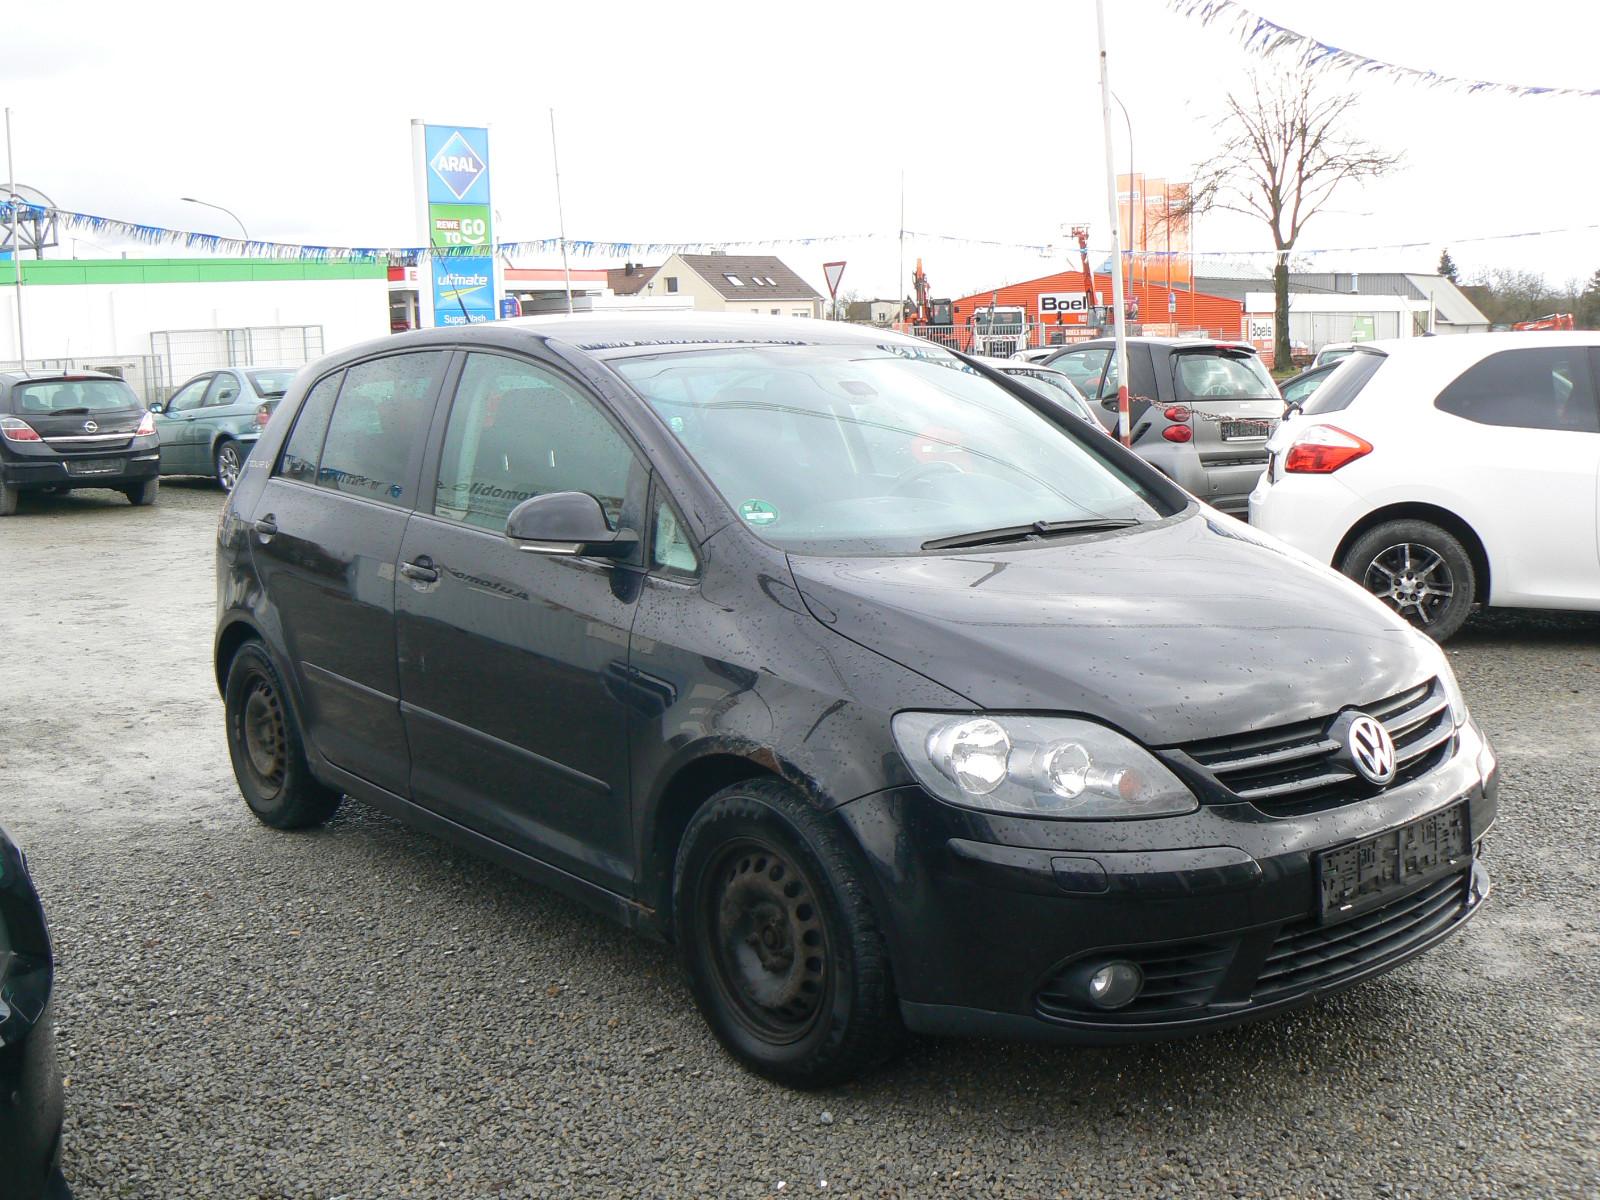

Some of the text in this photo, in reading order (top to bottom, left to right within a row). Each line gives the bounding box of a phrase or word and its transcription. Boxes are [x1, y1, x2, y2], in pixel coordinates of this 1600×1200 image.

[438, 156, 478, 173] ARAL
[436, 220, 459, 230] REWE
[461, 218, 486, 236] GO
[444, 232, 461, 244] TO
[437, 273, 488, 287] ultimate
[1041, 296, 1087, 311] Boel
[1252, 321, 1272, 337] Boels
